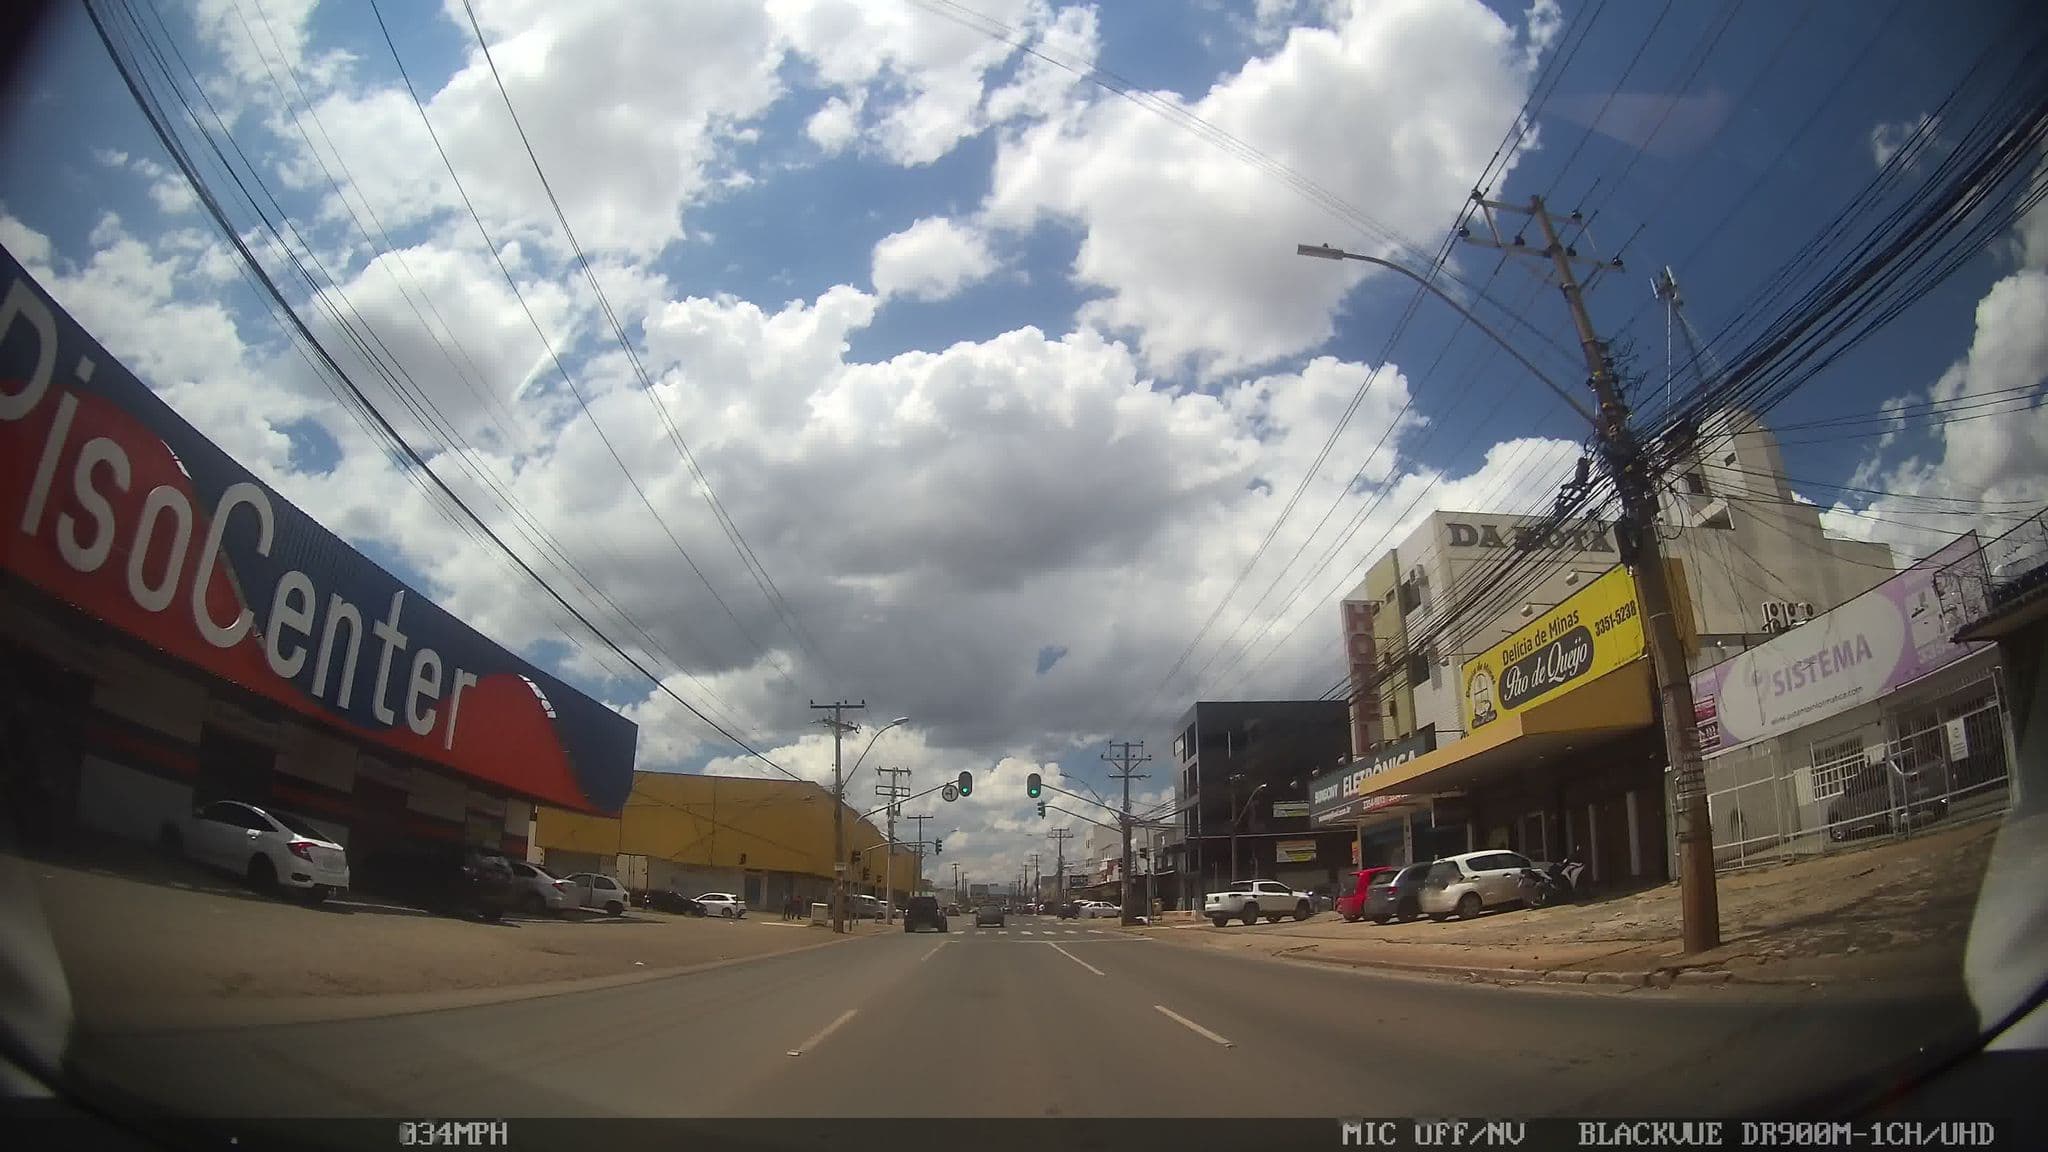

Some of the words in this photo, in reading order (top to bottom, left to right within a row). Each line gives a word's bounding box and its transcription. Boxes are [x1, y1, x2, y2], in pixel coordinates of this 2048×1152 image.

[1446, 523, 1506, 548] DA
[1503, 638, 1533, 665] Delícia
[1535, 629, 1547, 648] de
[1549, 610, 1580, 639] Minas
[1594, 600, 1637, 637] 3351-5238
[1531, 657, 1547, 687] de
[1548, 636, 1588, 683] Queijo
[1772, 633, 1873, 697] SISTEMA
